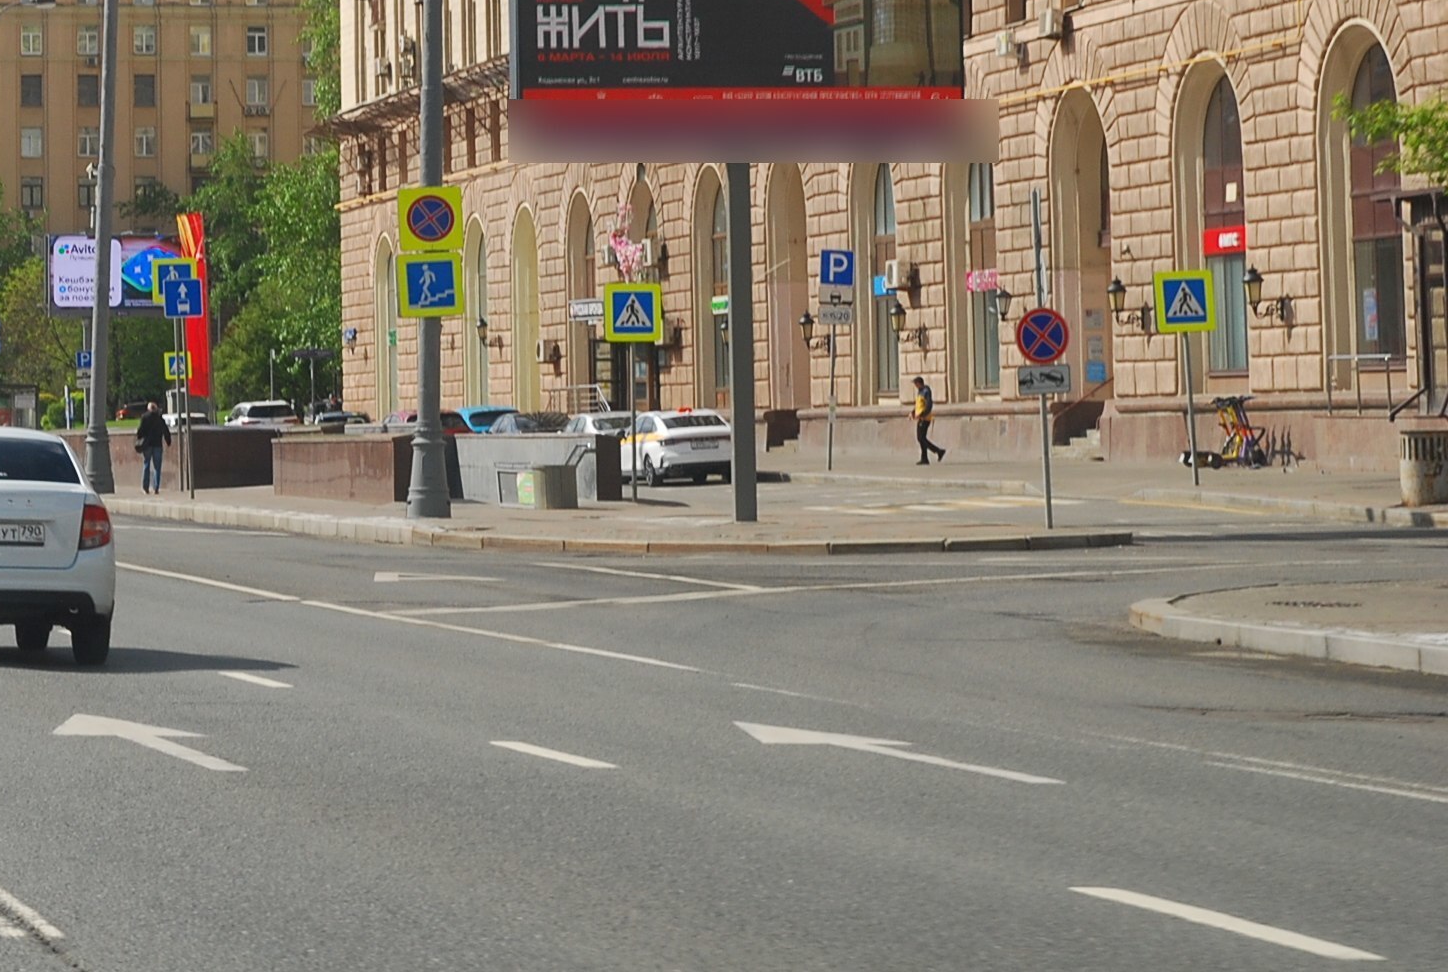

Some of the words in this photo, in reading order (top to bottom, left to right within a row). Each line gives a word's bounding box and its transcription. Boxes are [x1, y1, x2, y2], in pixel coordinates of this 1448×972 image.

[537, 3, 670, 49] ЖИТЬ
[549, 51, 596, 62] МАРТА
[627, 51, 670, 62] ИЮЛЯ
[795, 67, 823, 83] ВТБ
[829, 252, 848, 282] P
[21, 525, 42, 536] 790
